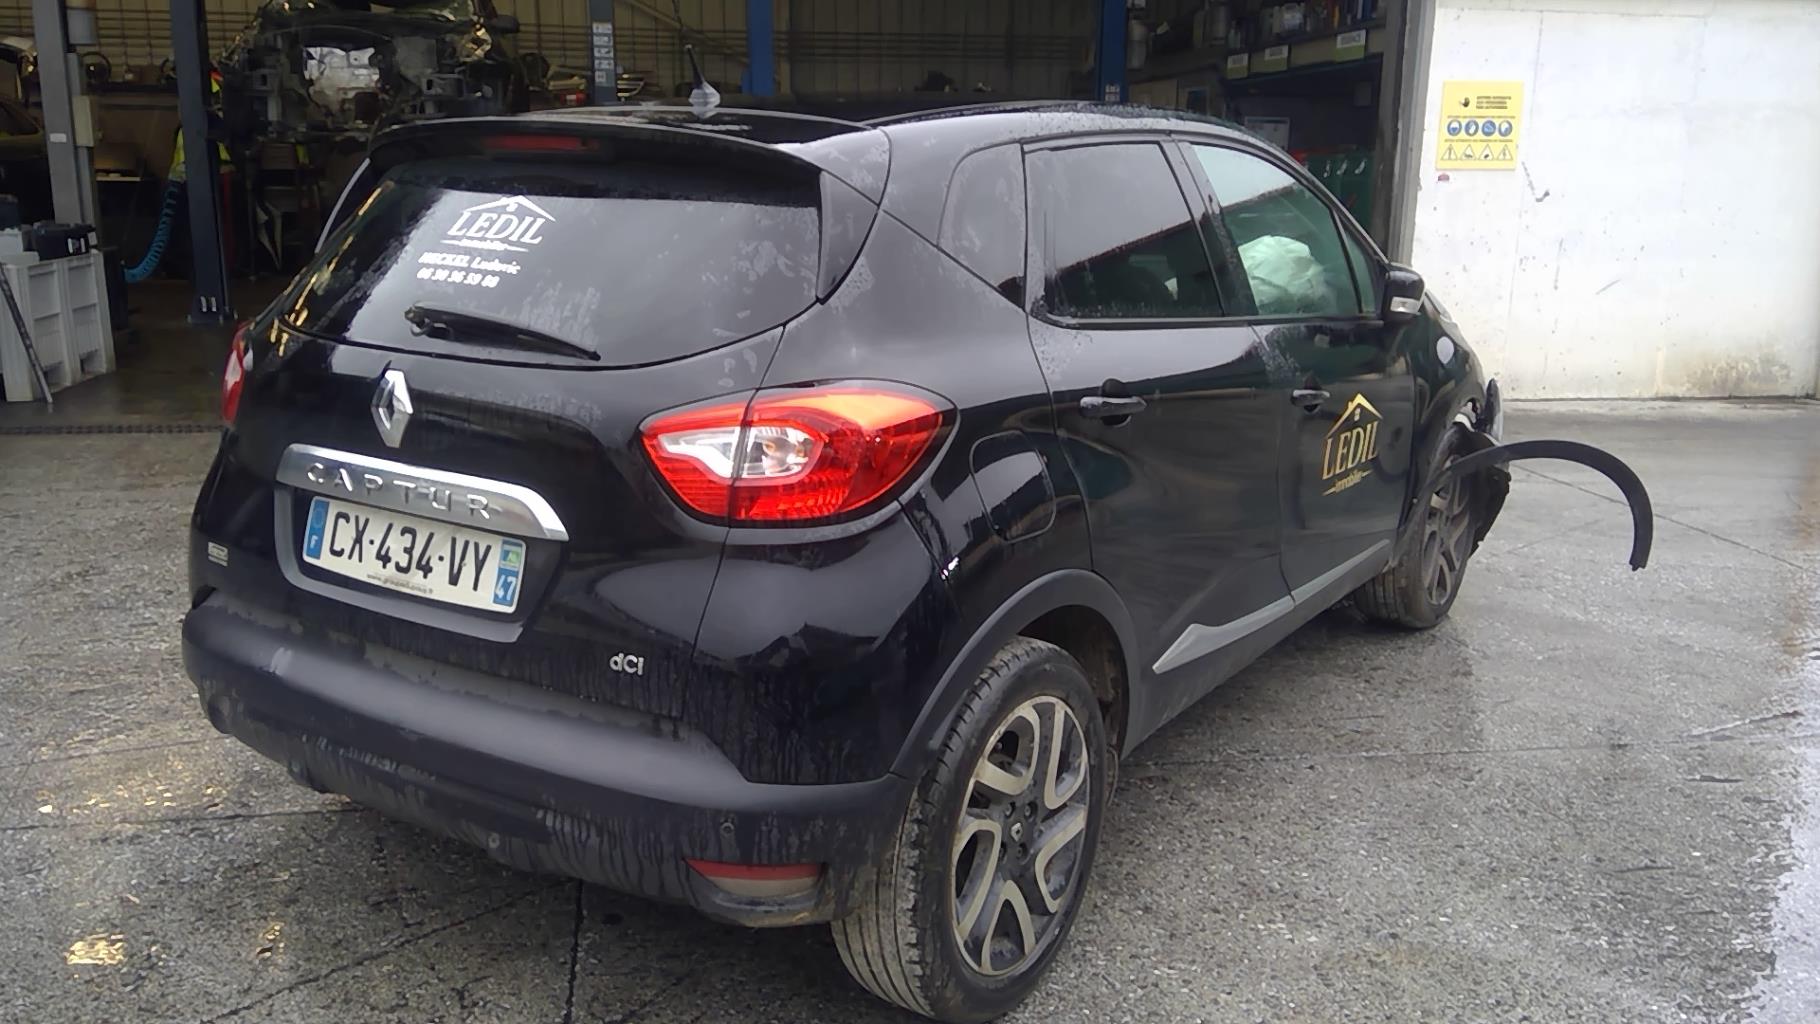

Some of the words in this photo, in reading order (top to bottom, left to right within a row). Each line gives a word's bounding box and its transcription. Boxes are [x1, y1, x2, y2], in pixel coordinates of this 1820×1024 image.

[447, 211, 546, 244] LEDIL
[1322, 421, 1379, 480] LEDIL
[307, 462, 490, 519] CAPTUR
[494, 573, 517, 601] 47
